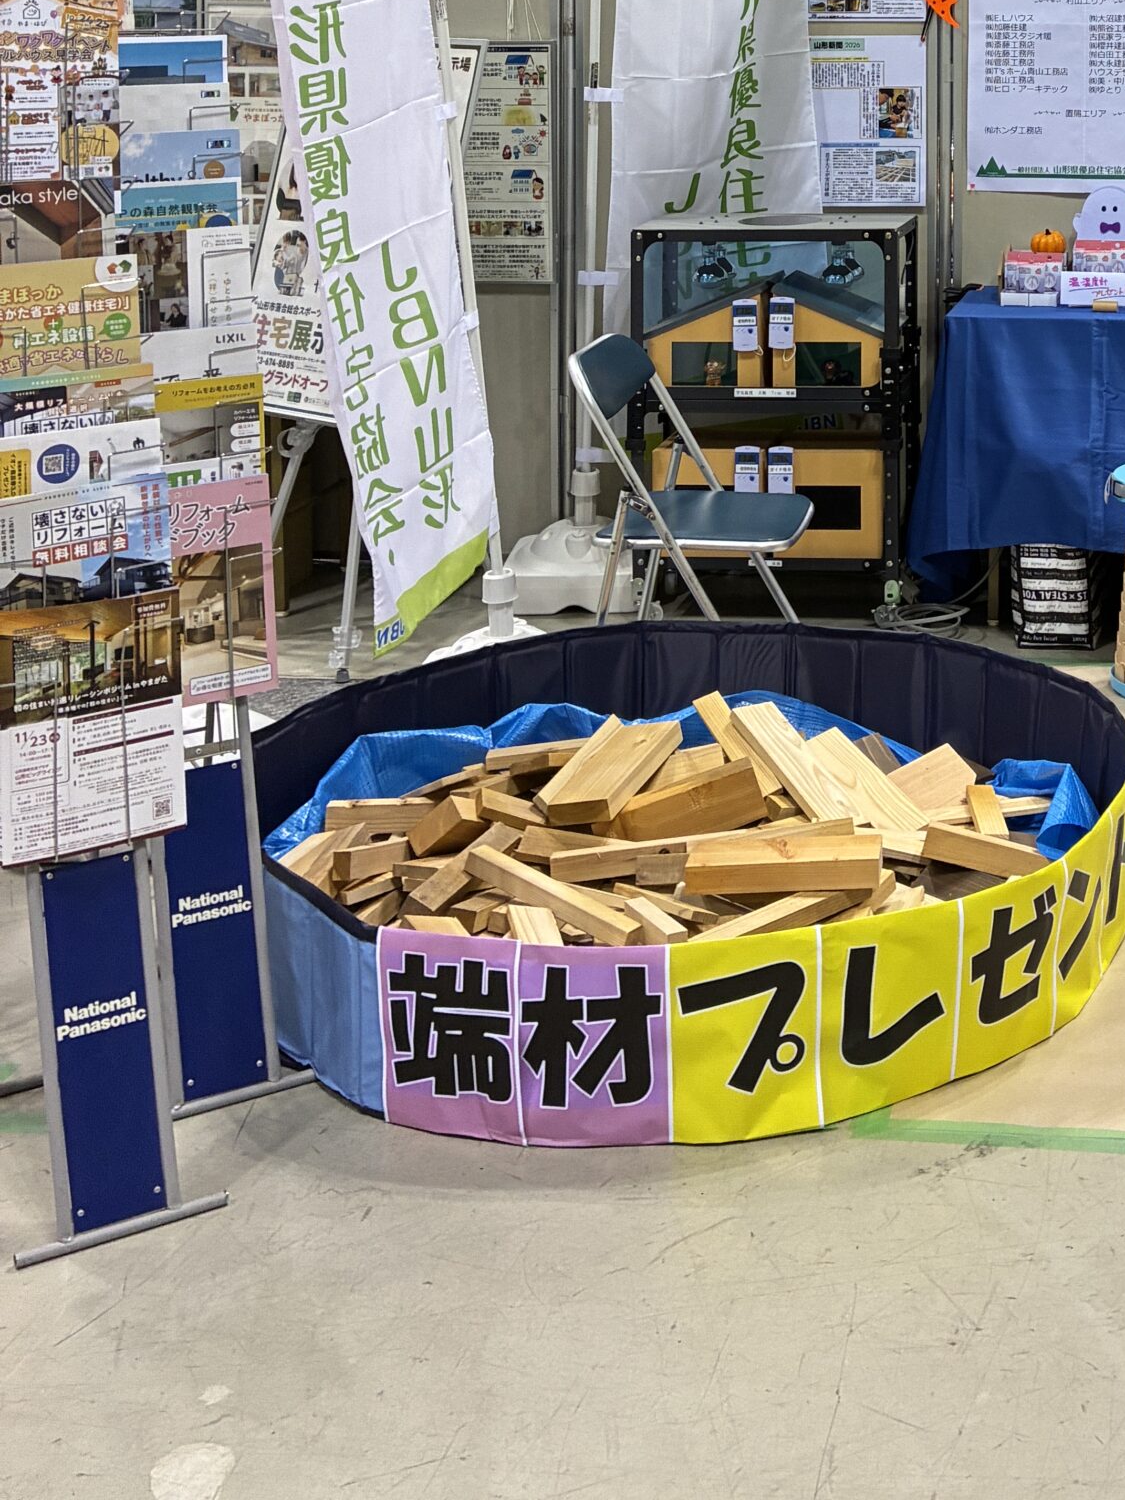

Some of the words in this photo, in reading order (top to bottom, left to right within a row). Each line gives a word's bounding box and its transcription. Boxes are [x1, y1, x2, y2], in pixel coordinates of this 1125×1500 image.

[38, 186, 78, 206] style
[216, 333, 247, 344] LIXIL
[34, 503, 105, 529] 壊さない
[36, 518, 125, 546] リフォーム
[34, 536, 128, 566] 無料相談会
[1039, 591, 1067, 601] STEAL
[178, 885, 244, 912] National
[172, 899, 252, 929] Panasonic
[64, 991, 138, 1024] National
[57, 1007, 147, 1042] Panasonic
